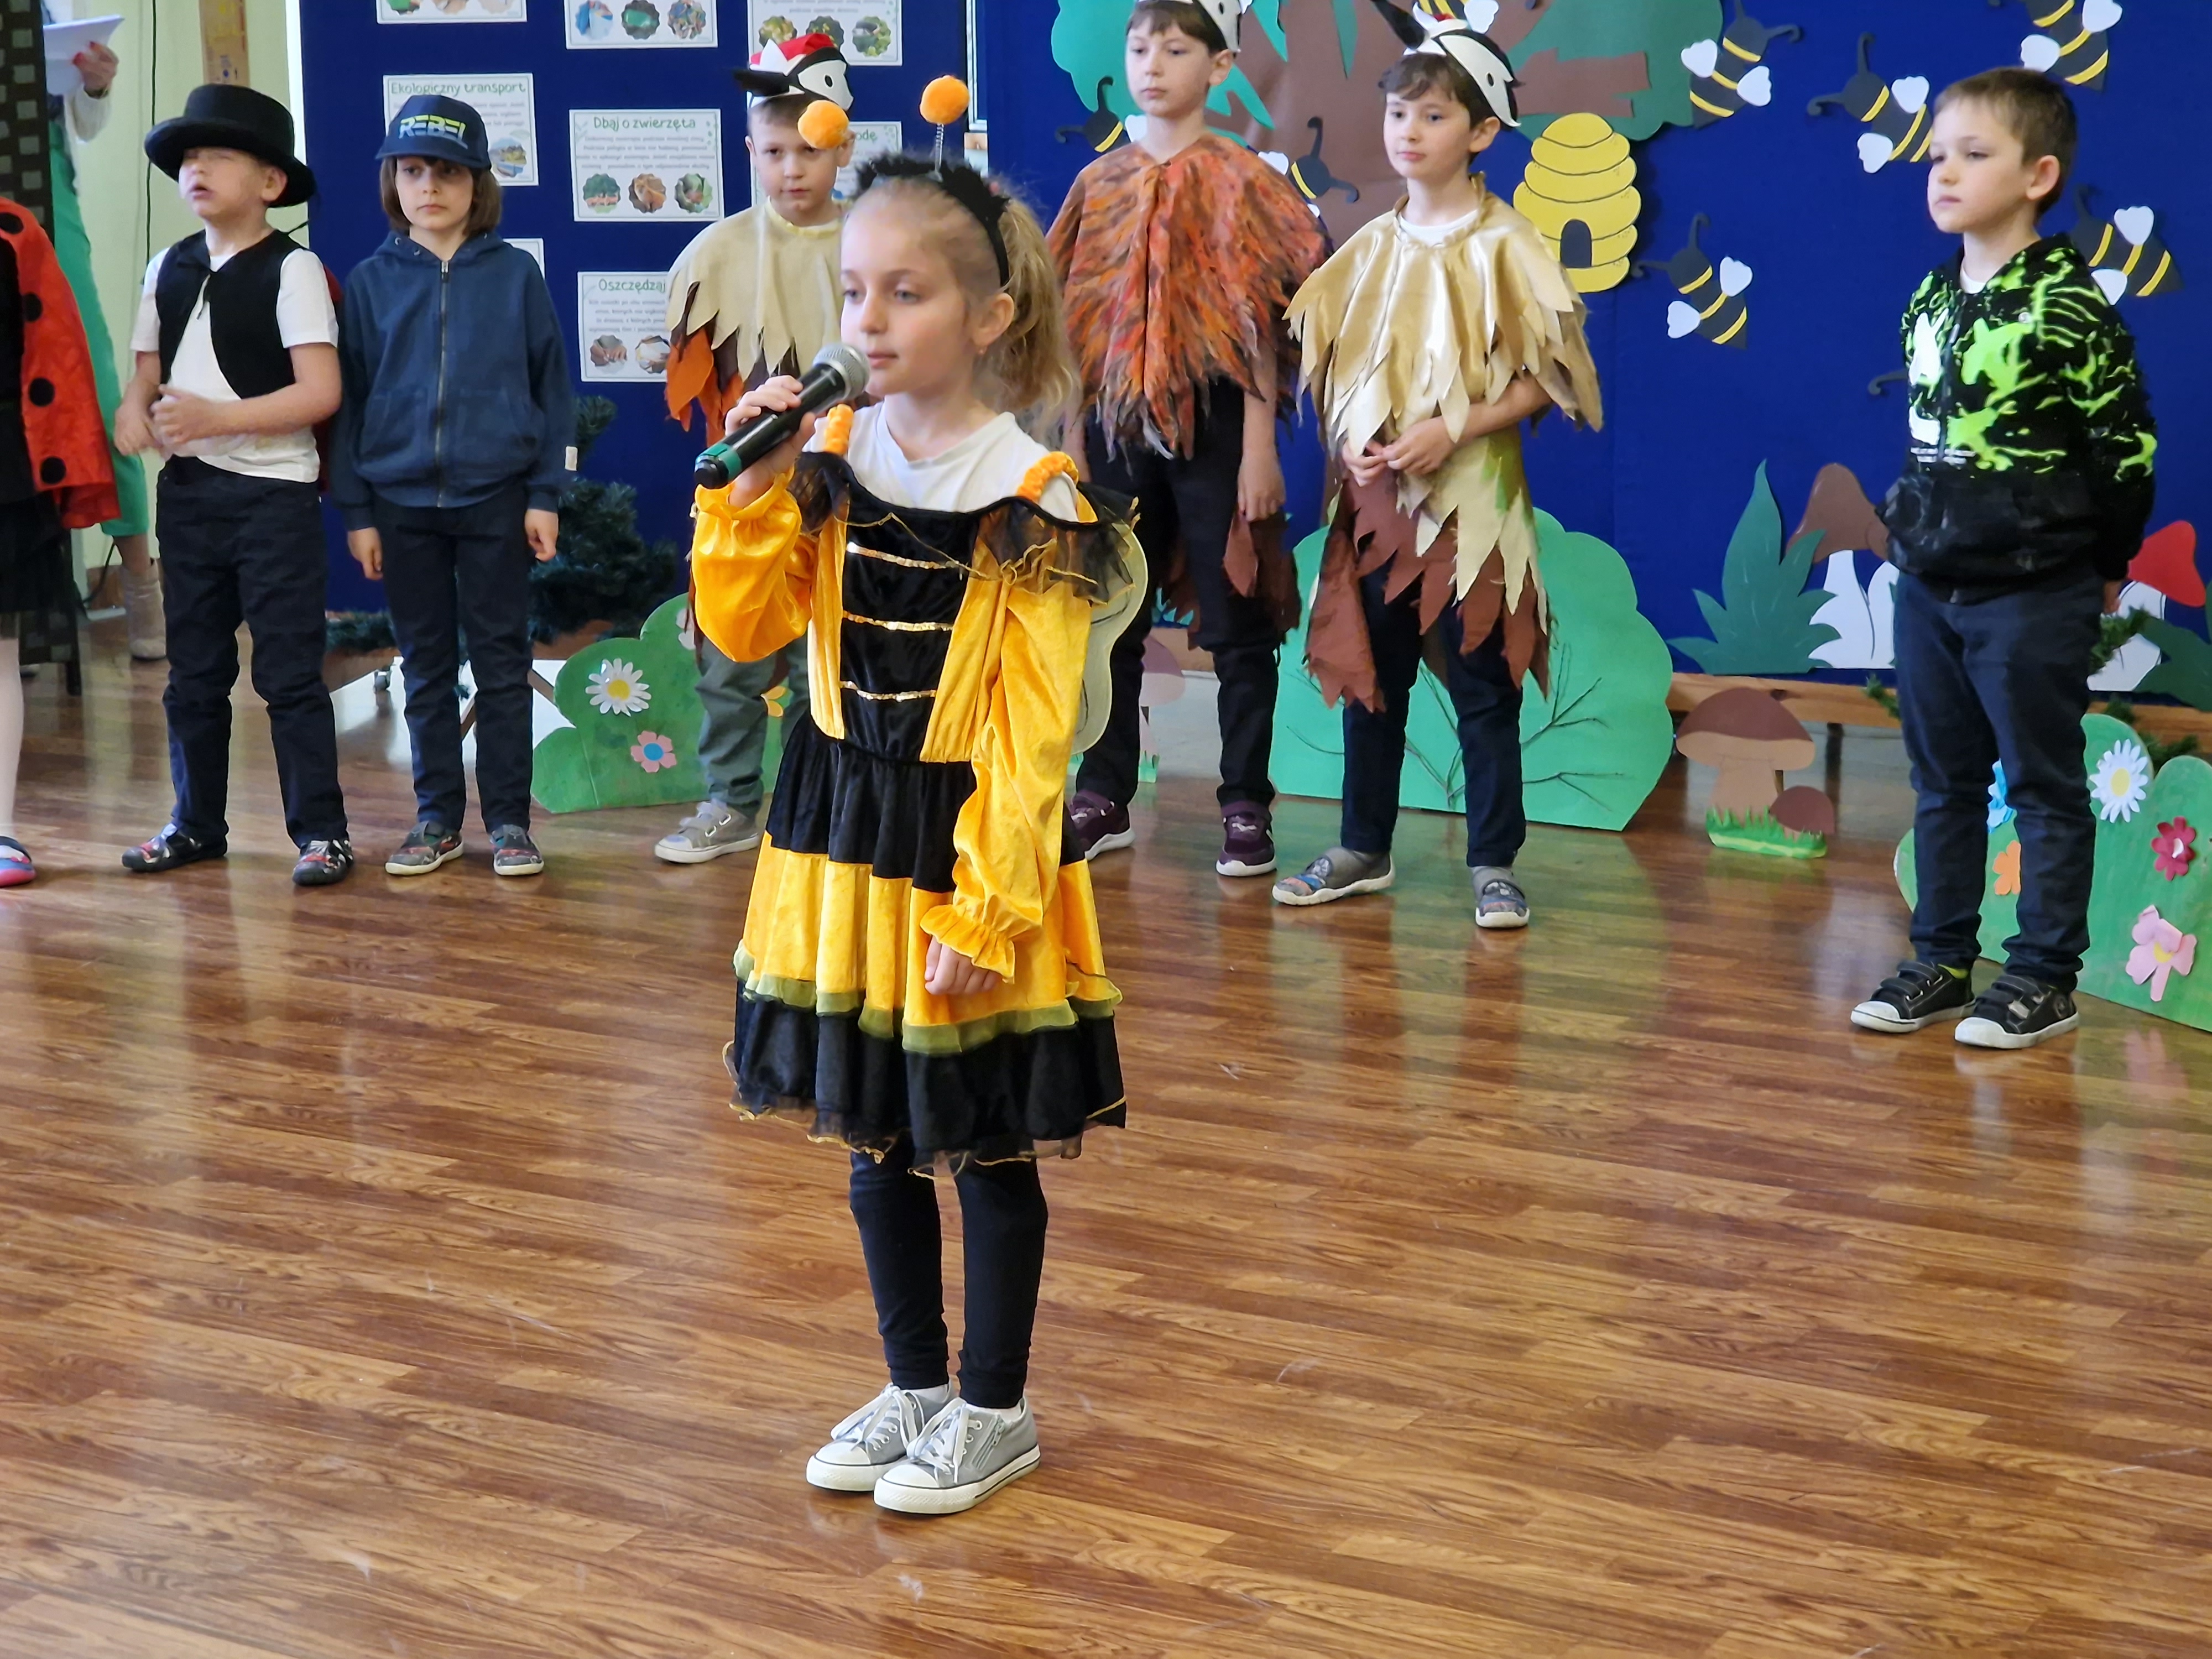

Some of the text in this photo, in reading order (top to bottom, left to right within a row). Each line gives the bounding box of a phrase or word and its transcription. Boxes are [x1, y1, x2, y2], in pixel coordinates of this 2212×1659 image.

[391, 82, 526, 97] Ekologiczny transport
[399, 114, 468, 150] REBEL
[593, 116, 696, 132] Dbaj o zwierzęta
[599, 278, 666, 294] Oszczędzaj
